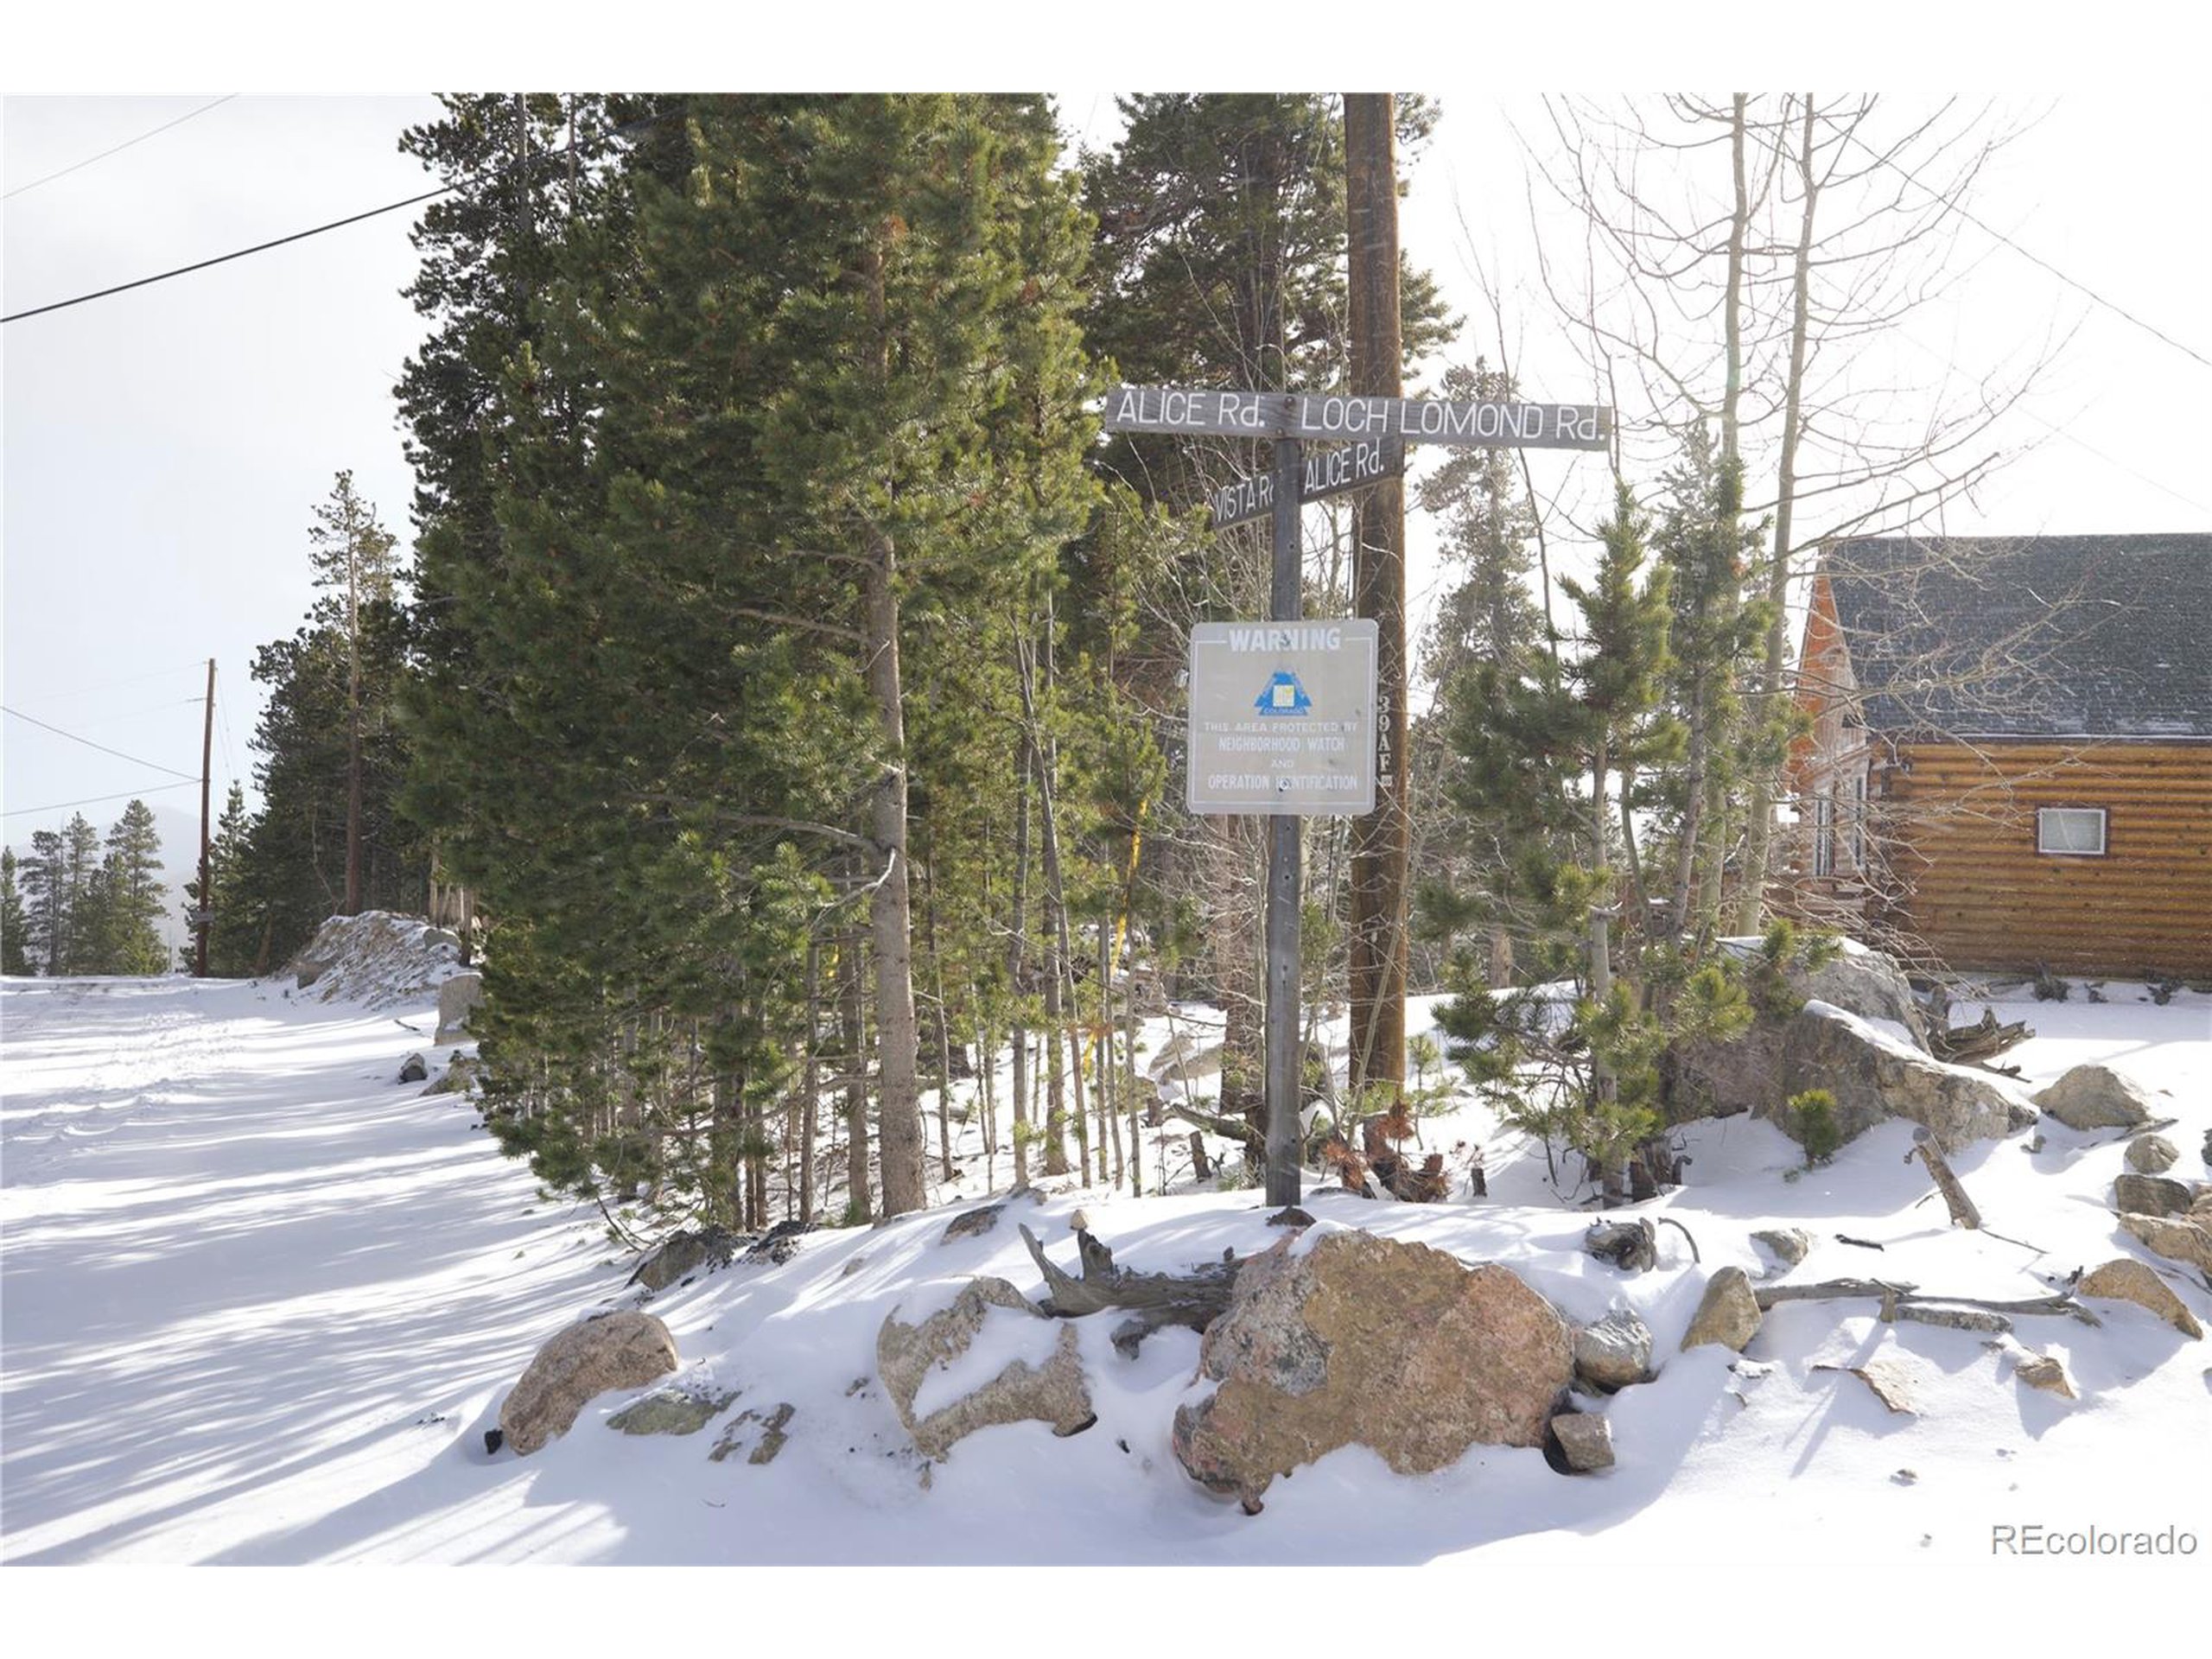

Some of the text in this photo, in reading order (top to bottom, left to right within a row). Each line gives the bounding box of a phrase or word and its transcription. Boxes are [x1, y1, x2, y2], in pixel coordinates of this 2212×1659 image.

[1116, 391, 1265, 428] ALICE Rd.
[1301, 397, 1605, 441] LOCH LOMOND Rd.
[1304, 436, 1384, 494] ALICE Rd.
[1214, 481, 1255, 522] VISTA
[1229, 627, 1341, 652] WARNING
[1205, 721, 1229, 732] THIS
[1234, 721, 1267, 732] AREA
[1272, 721, 1338, 732] PROTECTED
[1218, 736, 1345, 752] NEIGHBORHOOD WATCH
[1271, 760, 1294, 769] AND
[1208, 774, 1357, 790] OPERATION INTIFICATION
